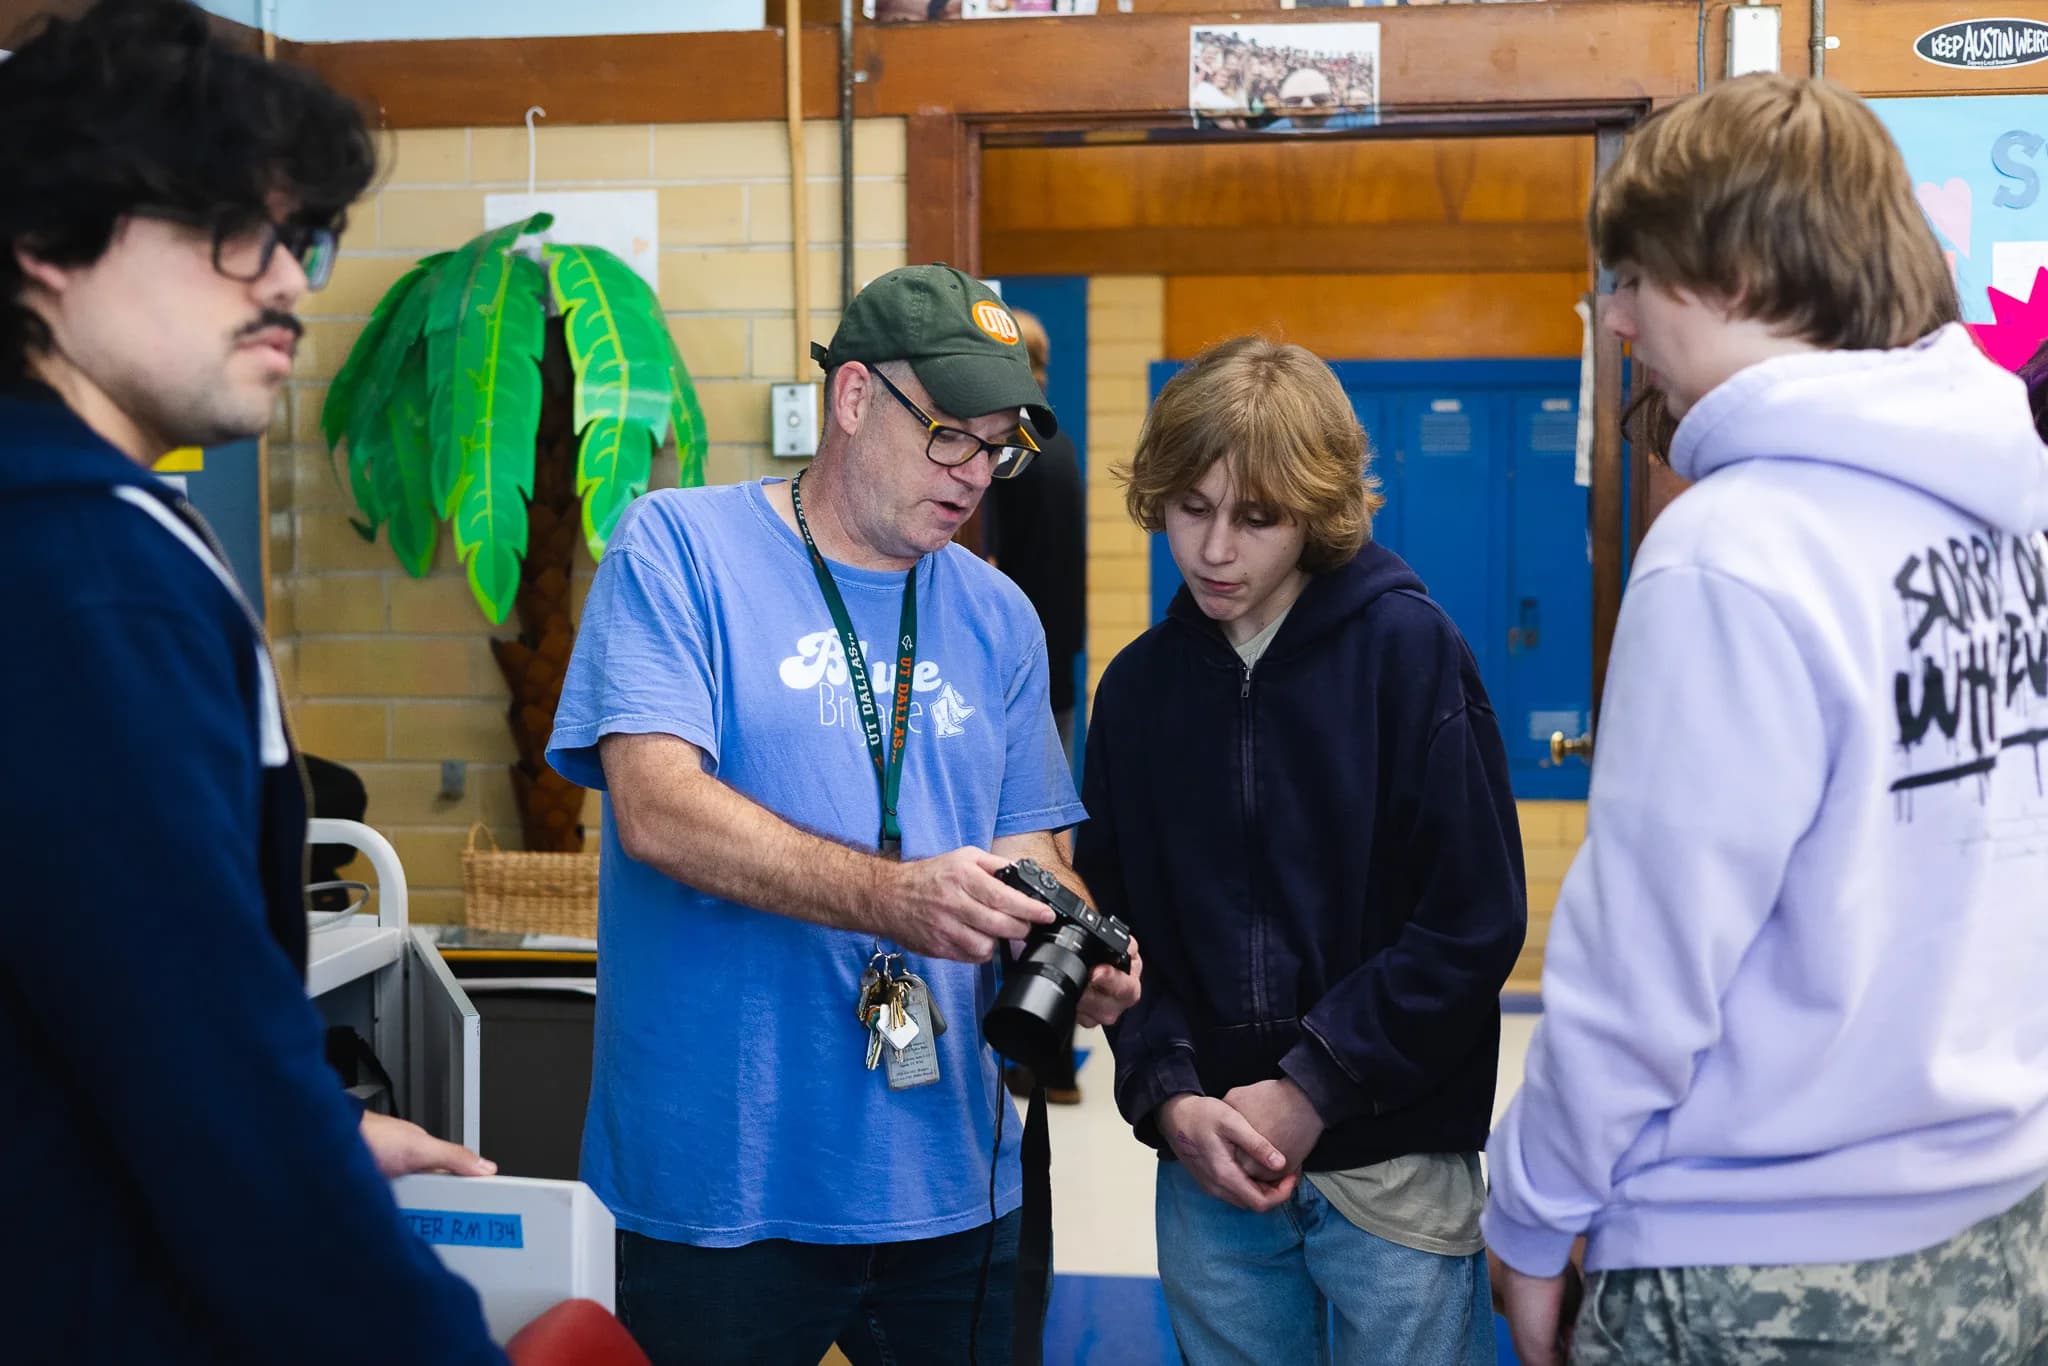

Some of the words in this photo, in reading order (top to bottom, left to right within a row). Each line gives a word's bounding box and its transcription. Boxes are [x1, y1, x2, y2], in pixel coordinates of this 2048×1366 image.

[1931, 34, 1963, 58] KEEP
[1963, 25, 2013, 60] AUSTIN
[899, 657, 912, 678] UT
[865, 721, 880, 746] UT
[451, 1218, 481, 1241] RM
[488, 1220, 516, 1241] 134
